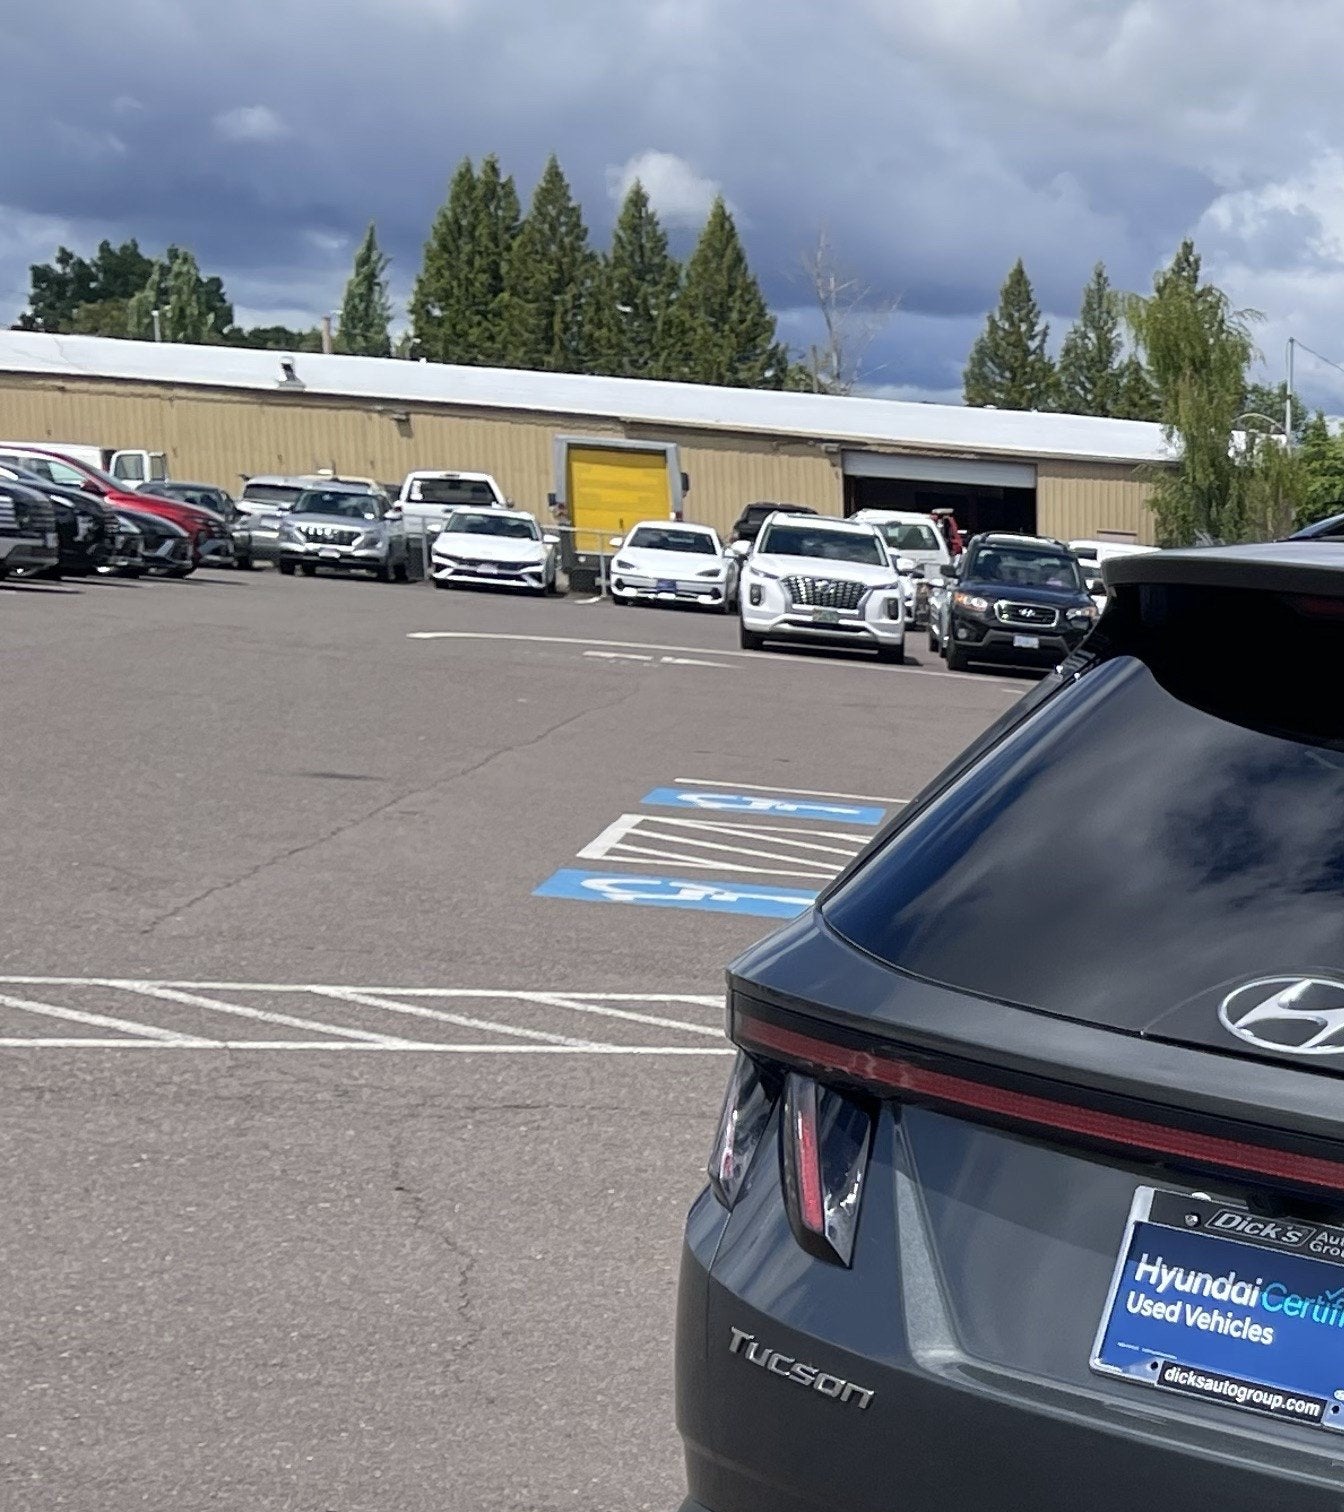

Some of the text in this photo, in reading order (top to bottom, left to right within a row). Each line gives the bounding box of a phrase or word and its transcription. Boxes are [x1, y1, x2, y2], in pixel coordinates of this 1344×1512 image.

[1213, 1212, 1304, 1244] Dick's
[1133, 1252, 1263, 1309] Hyundai
[1125, 1290, 1275, 1346] Used Vehicles
[1163, 1366, 1322, 1417] dicksautogroup.com
